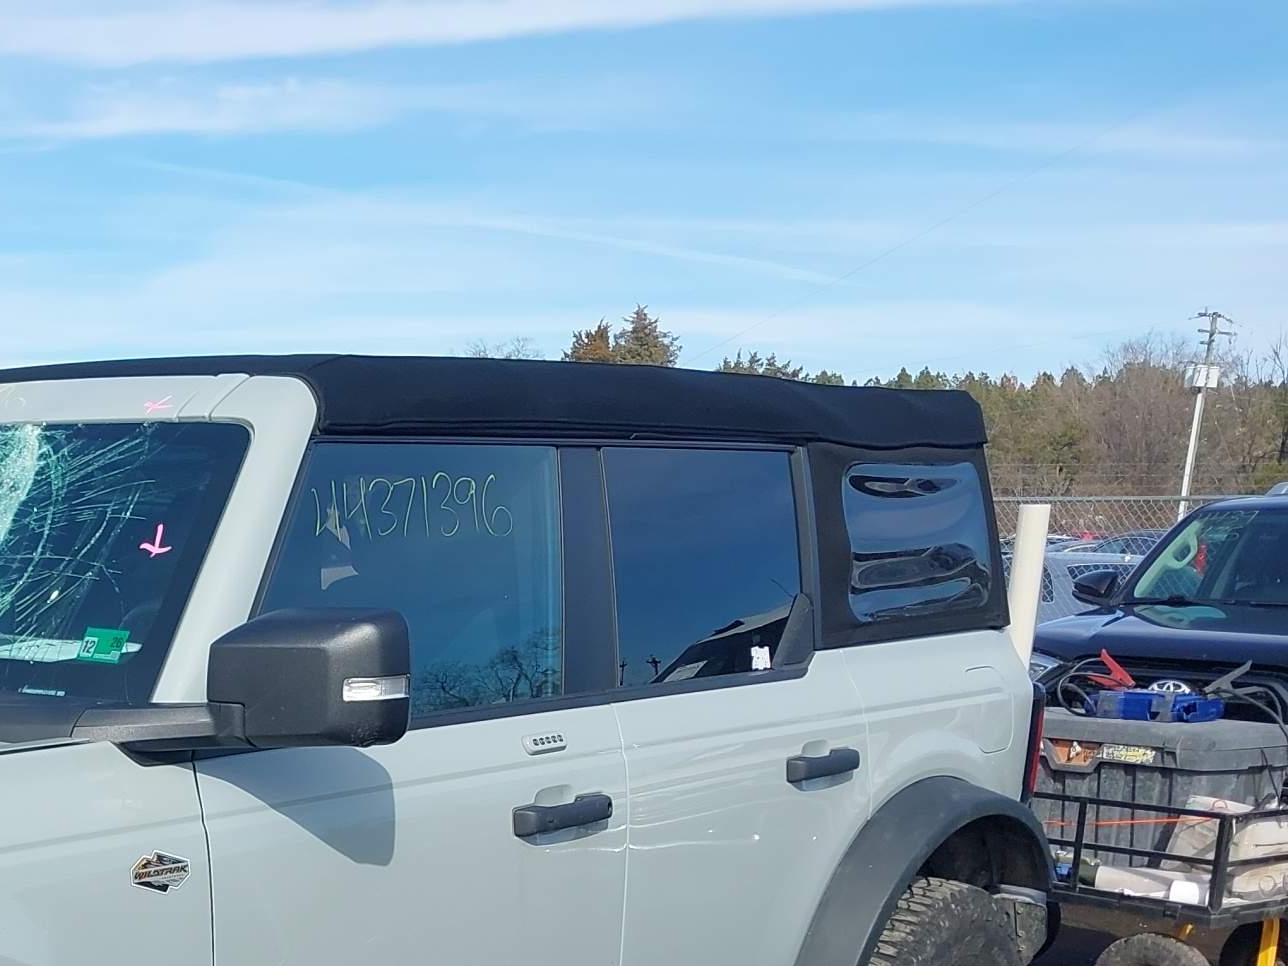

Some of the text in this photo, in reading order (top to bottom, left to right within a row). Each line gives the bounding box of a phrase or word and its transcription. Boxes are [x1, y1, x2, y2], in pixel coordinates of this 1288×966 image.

[311, 471, 513, 540] 44371396
[82, 639, 96, 654] 12
[134, 863, 189, 881] WILDTRAK
